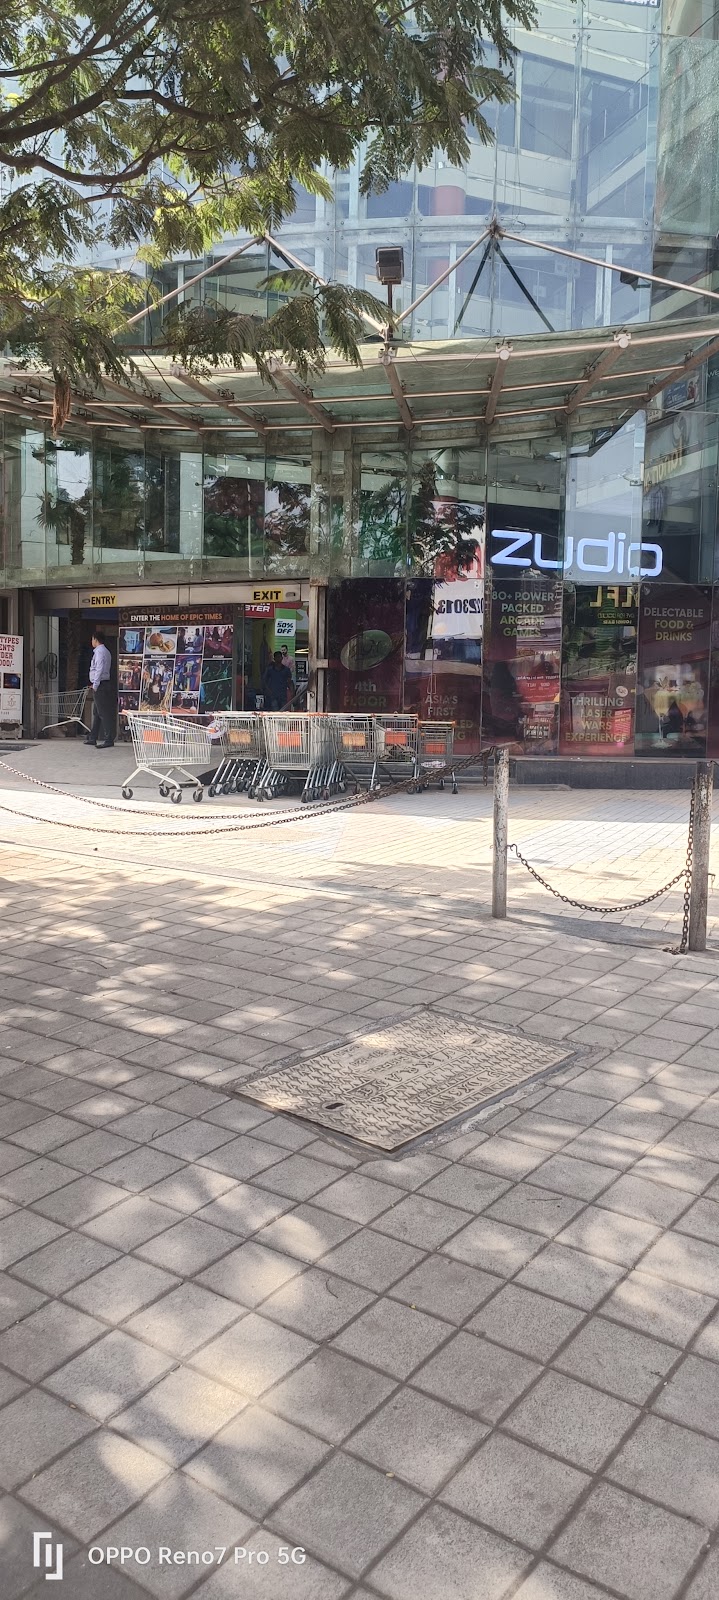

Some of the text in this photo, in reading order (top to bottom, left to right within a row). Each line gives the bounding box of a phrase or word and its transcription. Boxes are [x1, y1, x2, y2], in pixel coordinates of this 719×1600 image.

[490, 529, 663, 578] zudio
[91, 595, 117, 605] ENTRY
[253, 590, 282, 601] EXIT
[492, 591, 554, 602] 80+ POWER
[501, 603, 544, 614] PACKED
[643, 607, 704, 618] DELECTABLE
[149, 614, 160, 622] THE
[204, 612, 223, 620] TIMES
[654, 620, 694, 631] FOOD &
[503, 627, 542, 637] GAMES
[655, 632, 692, 642] DRINKS
[0, 636, 20, 645] TYPES
[355, 680, 377, 692] 4th
[343, 695, 388, 707] FLOOR
[425, 694, 458, 705] ASIA'S
[570, 696, 624, 707] THRILLING
[427, 706, 455, 717] FIRST
[580, 708, 613, 719] LASER
[581, 719, 613, 730] WARS
[565, 732, 628, 744] EXPERIENCE
